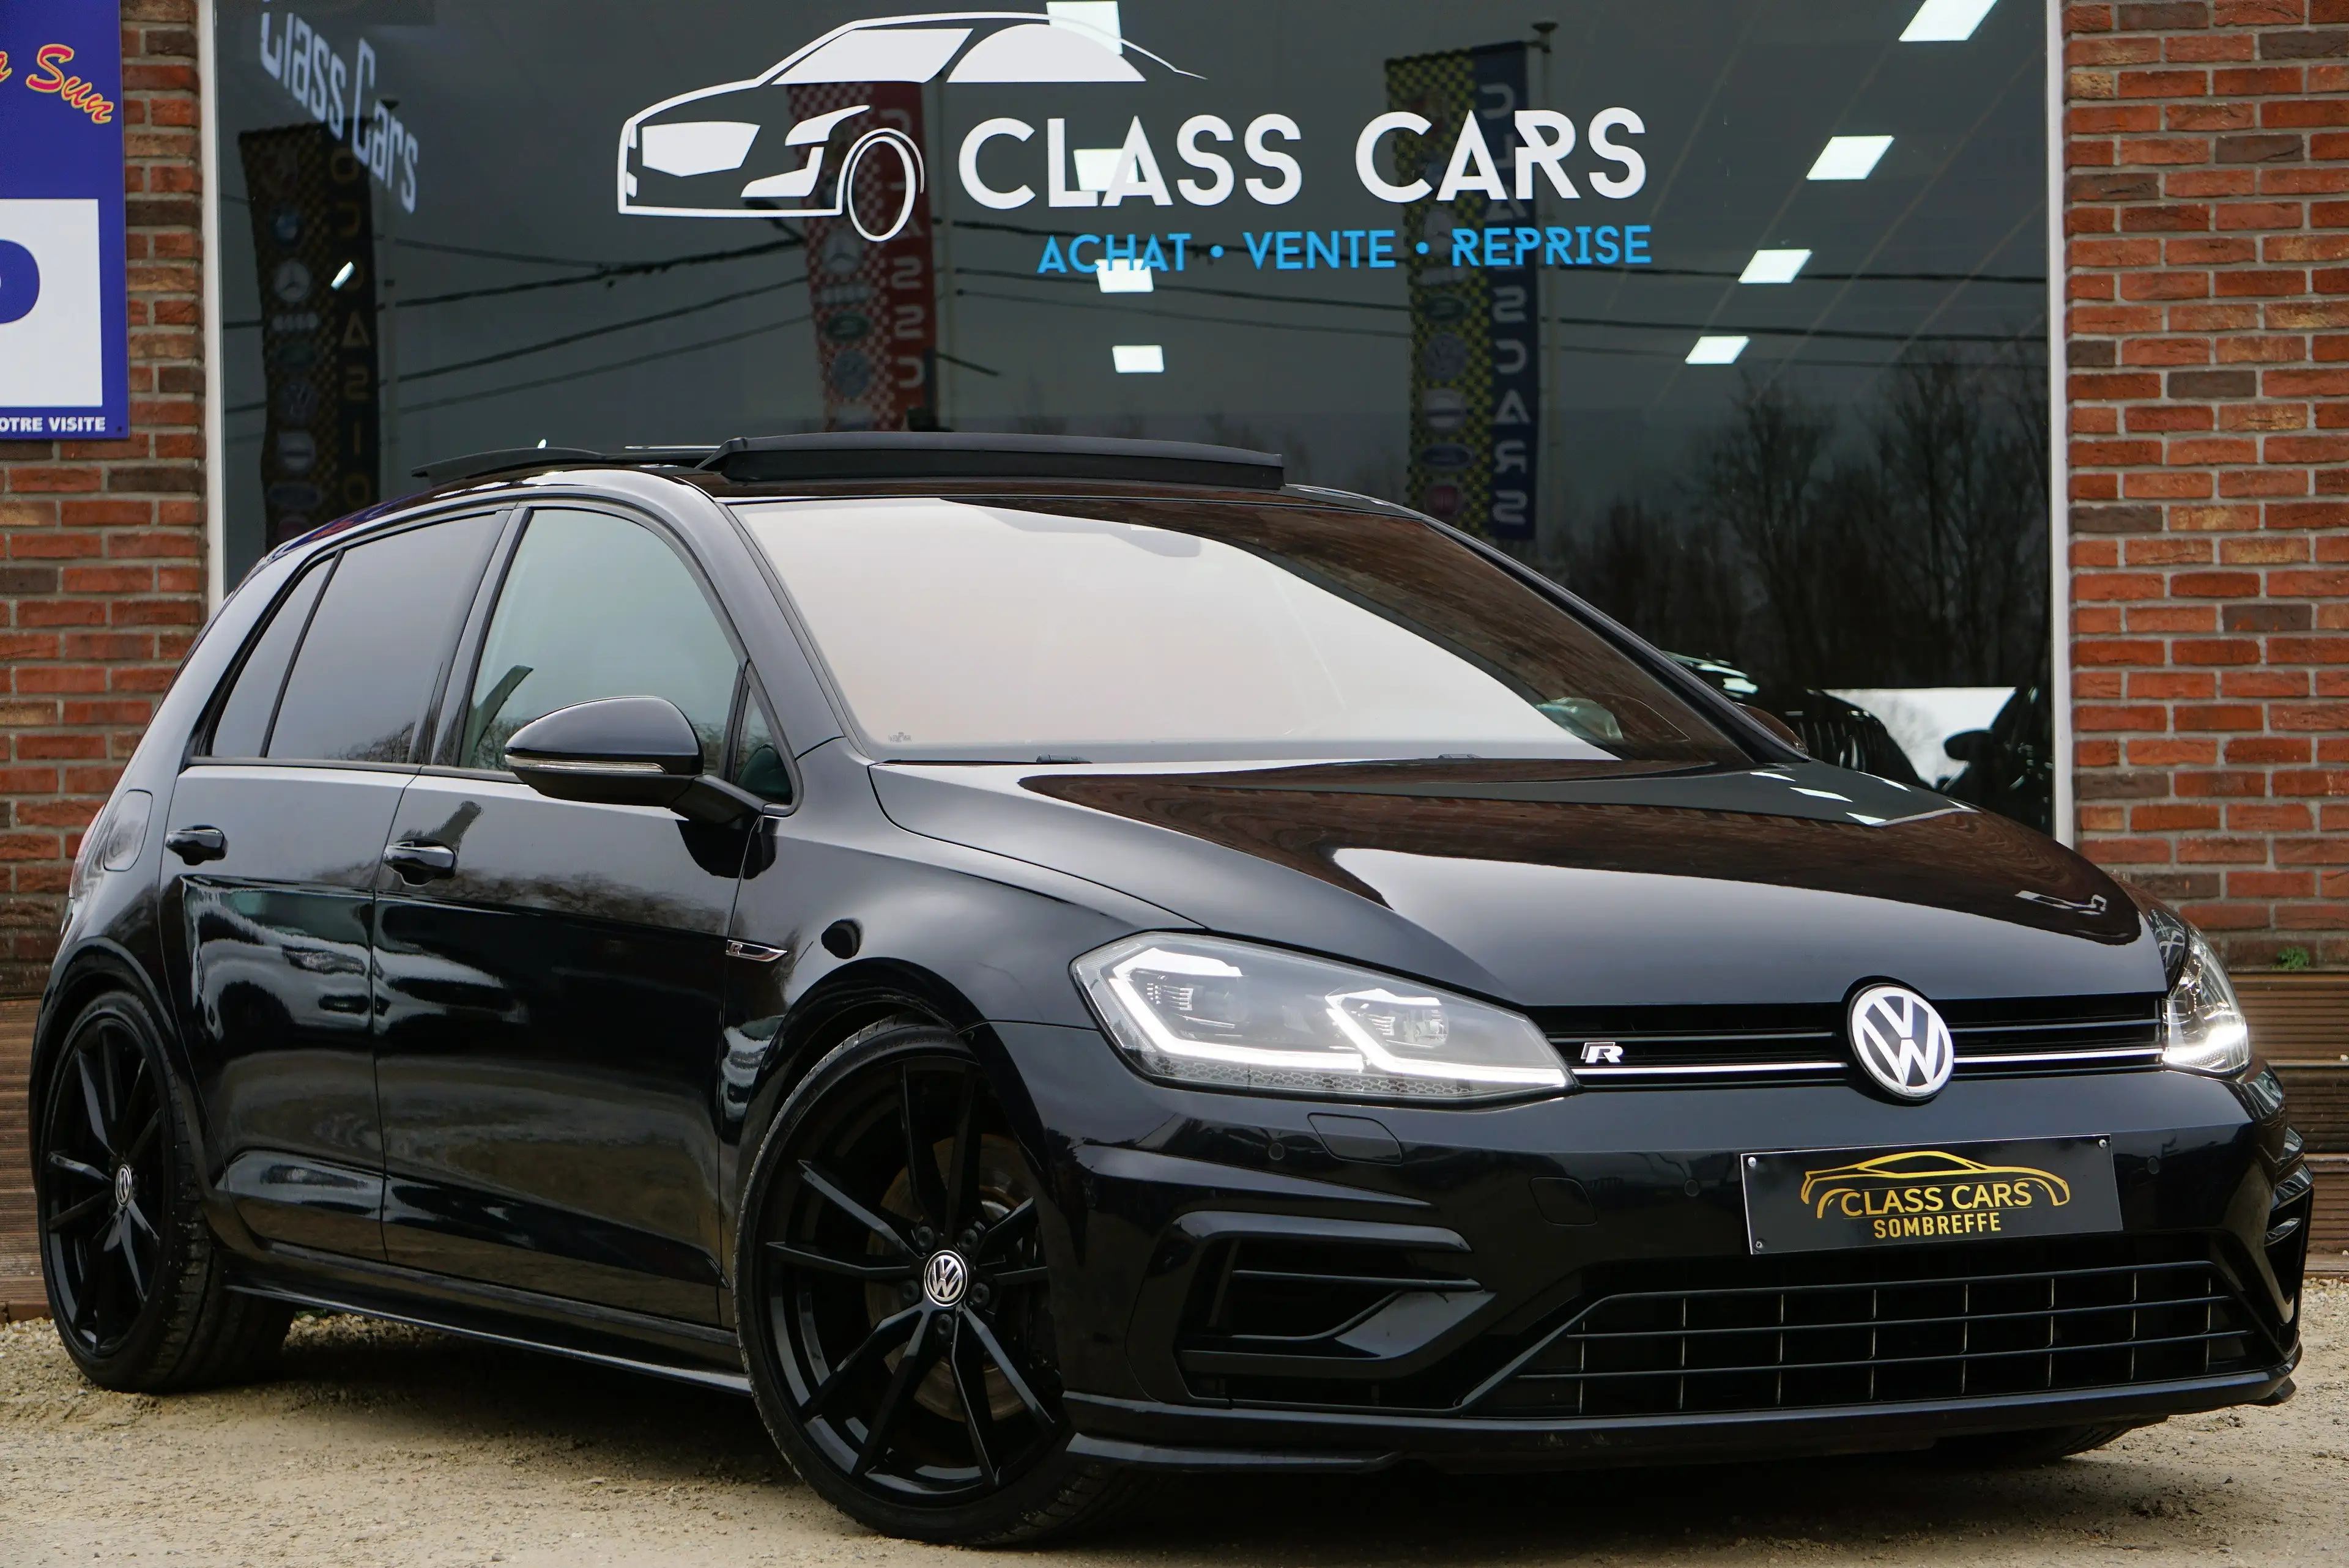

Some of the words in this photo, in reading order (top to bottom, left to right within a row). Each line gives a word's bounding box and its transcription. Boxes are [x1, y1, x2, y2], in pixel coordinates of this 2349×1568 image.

[26, 43, 114, 124] Sun
[352, 37, 418, 215] Cars
[958, 113, 1302, 210] CLASS
[1355, 106, 1647, 204] CARS
[1037, 232, 1192, 274] ACHAT
[1242, 229, 1397, 270] VENTE
[1452, 224, 1652, 268] REPRISE
[0, 417, 43, 432] OTRE
[48, 416, 106, 432] VISITE
[1581, 1042, 1623, 1063] R
[1841, 1186, 1944, 1217] CLASS
[1951, 1182, 2032, 1210] CARS
[1874, 1212, 2002, 1239] SOMBREFFE
